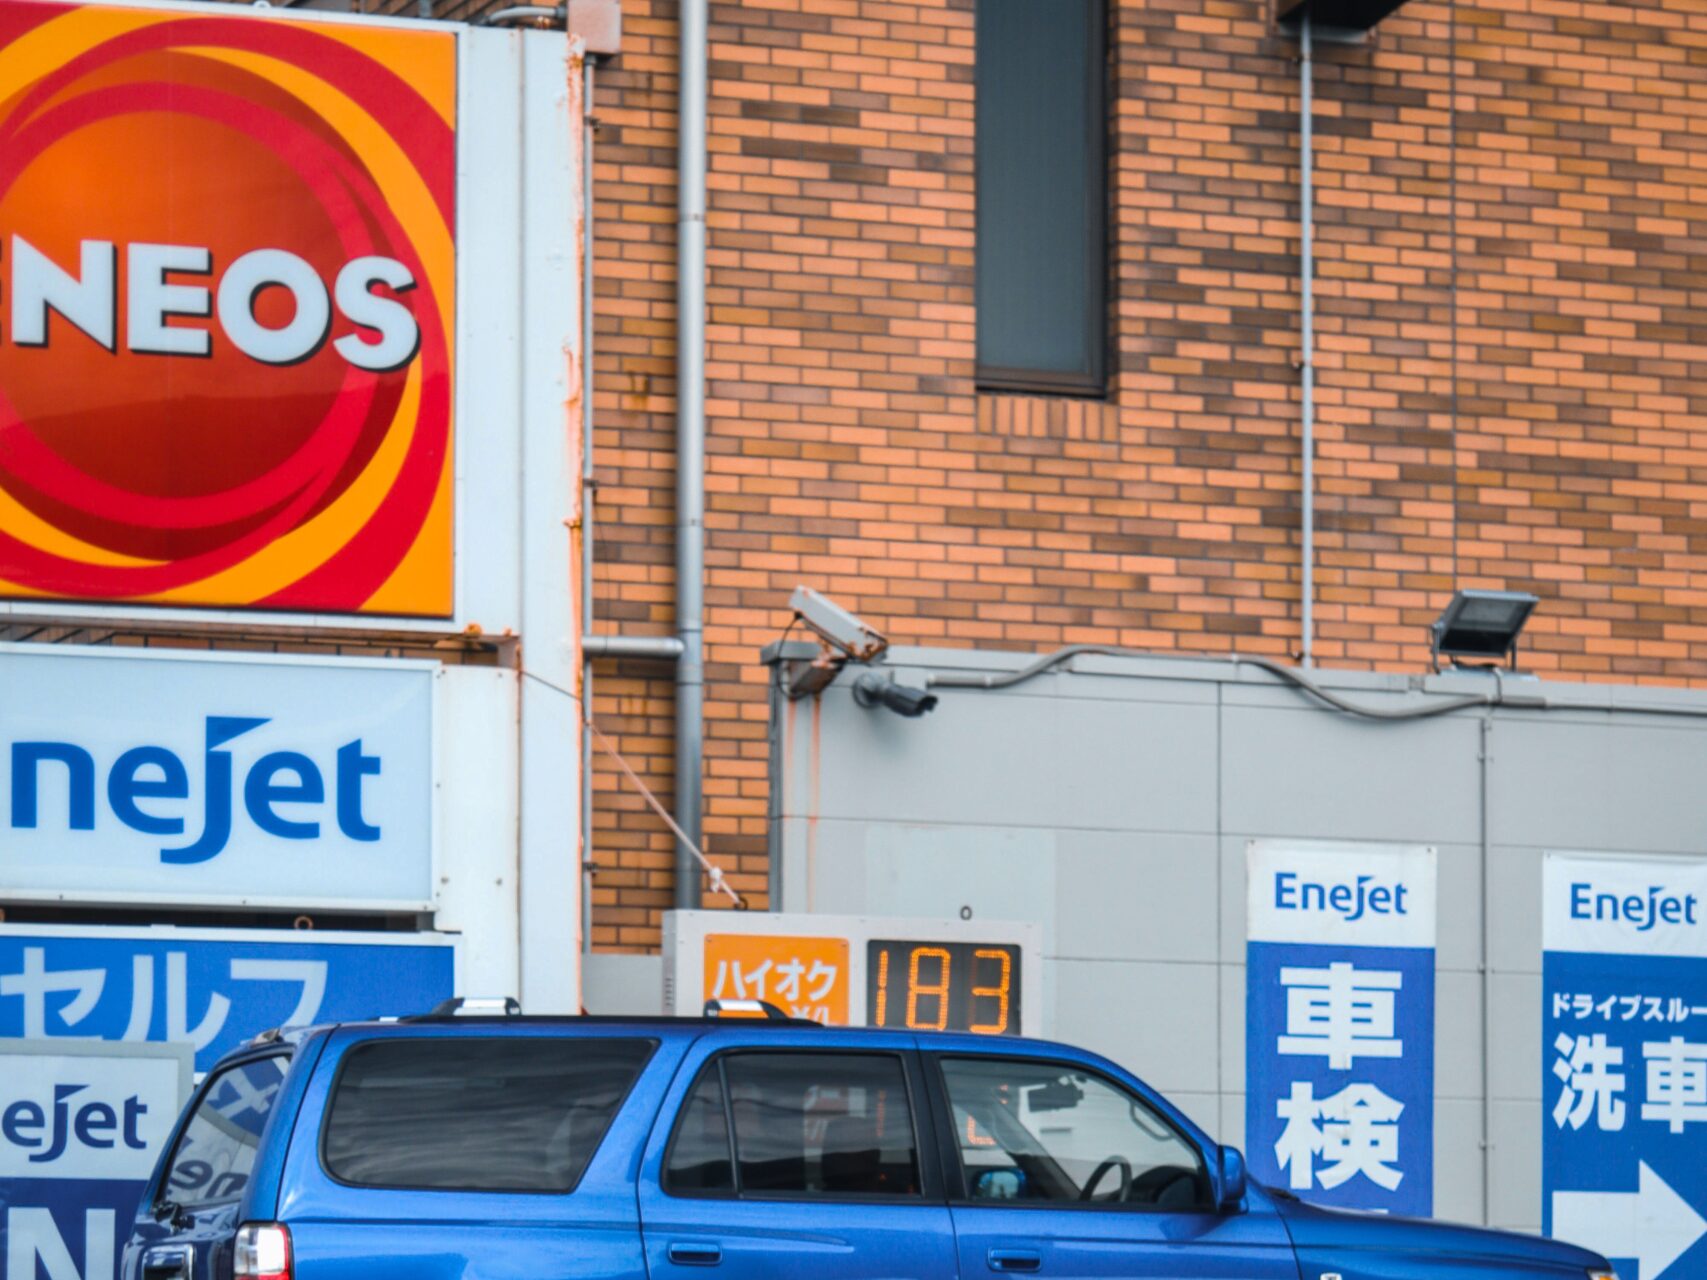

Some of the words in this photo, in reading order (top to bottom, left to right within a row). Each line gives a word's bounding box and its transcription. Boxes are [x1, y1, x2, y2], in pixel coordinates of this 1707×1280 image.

[1275, 872, 1408, 921] Enejet
[1571, 883, 1697, 931] Enejet
[0, 947, 329, 1053] セルフ
[712, 957, 837, 1002] ハイオク
[875, 947, 1011, 1035] 183
[1552, 992, 1707, 1024] ドライブスルー
[1275, 962, 1405, 1192] 車検
[1552, 1032, 1707, 1134] 洗車
